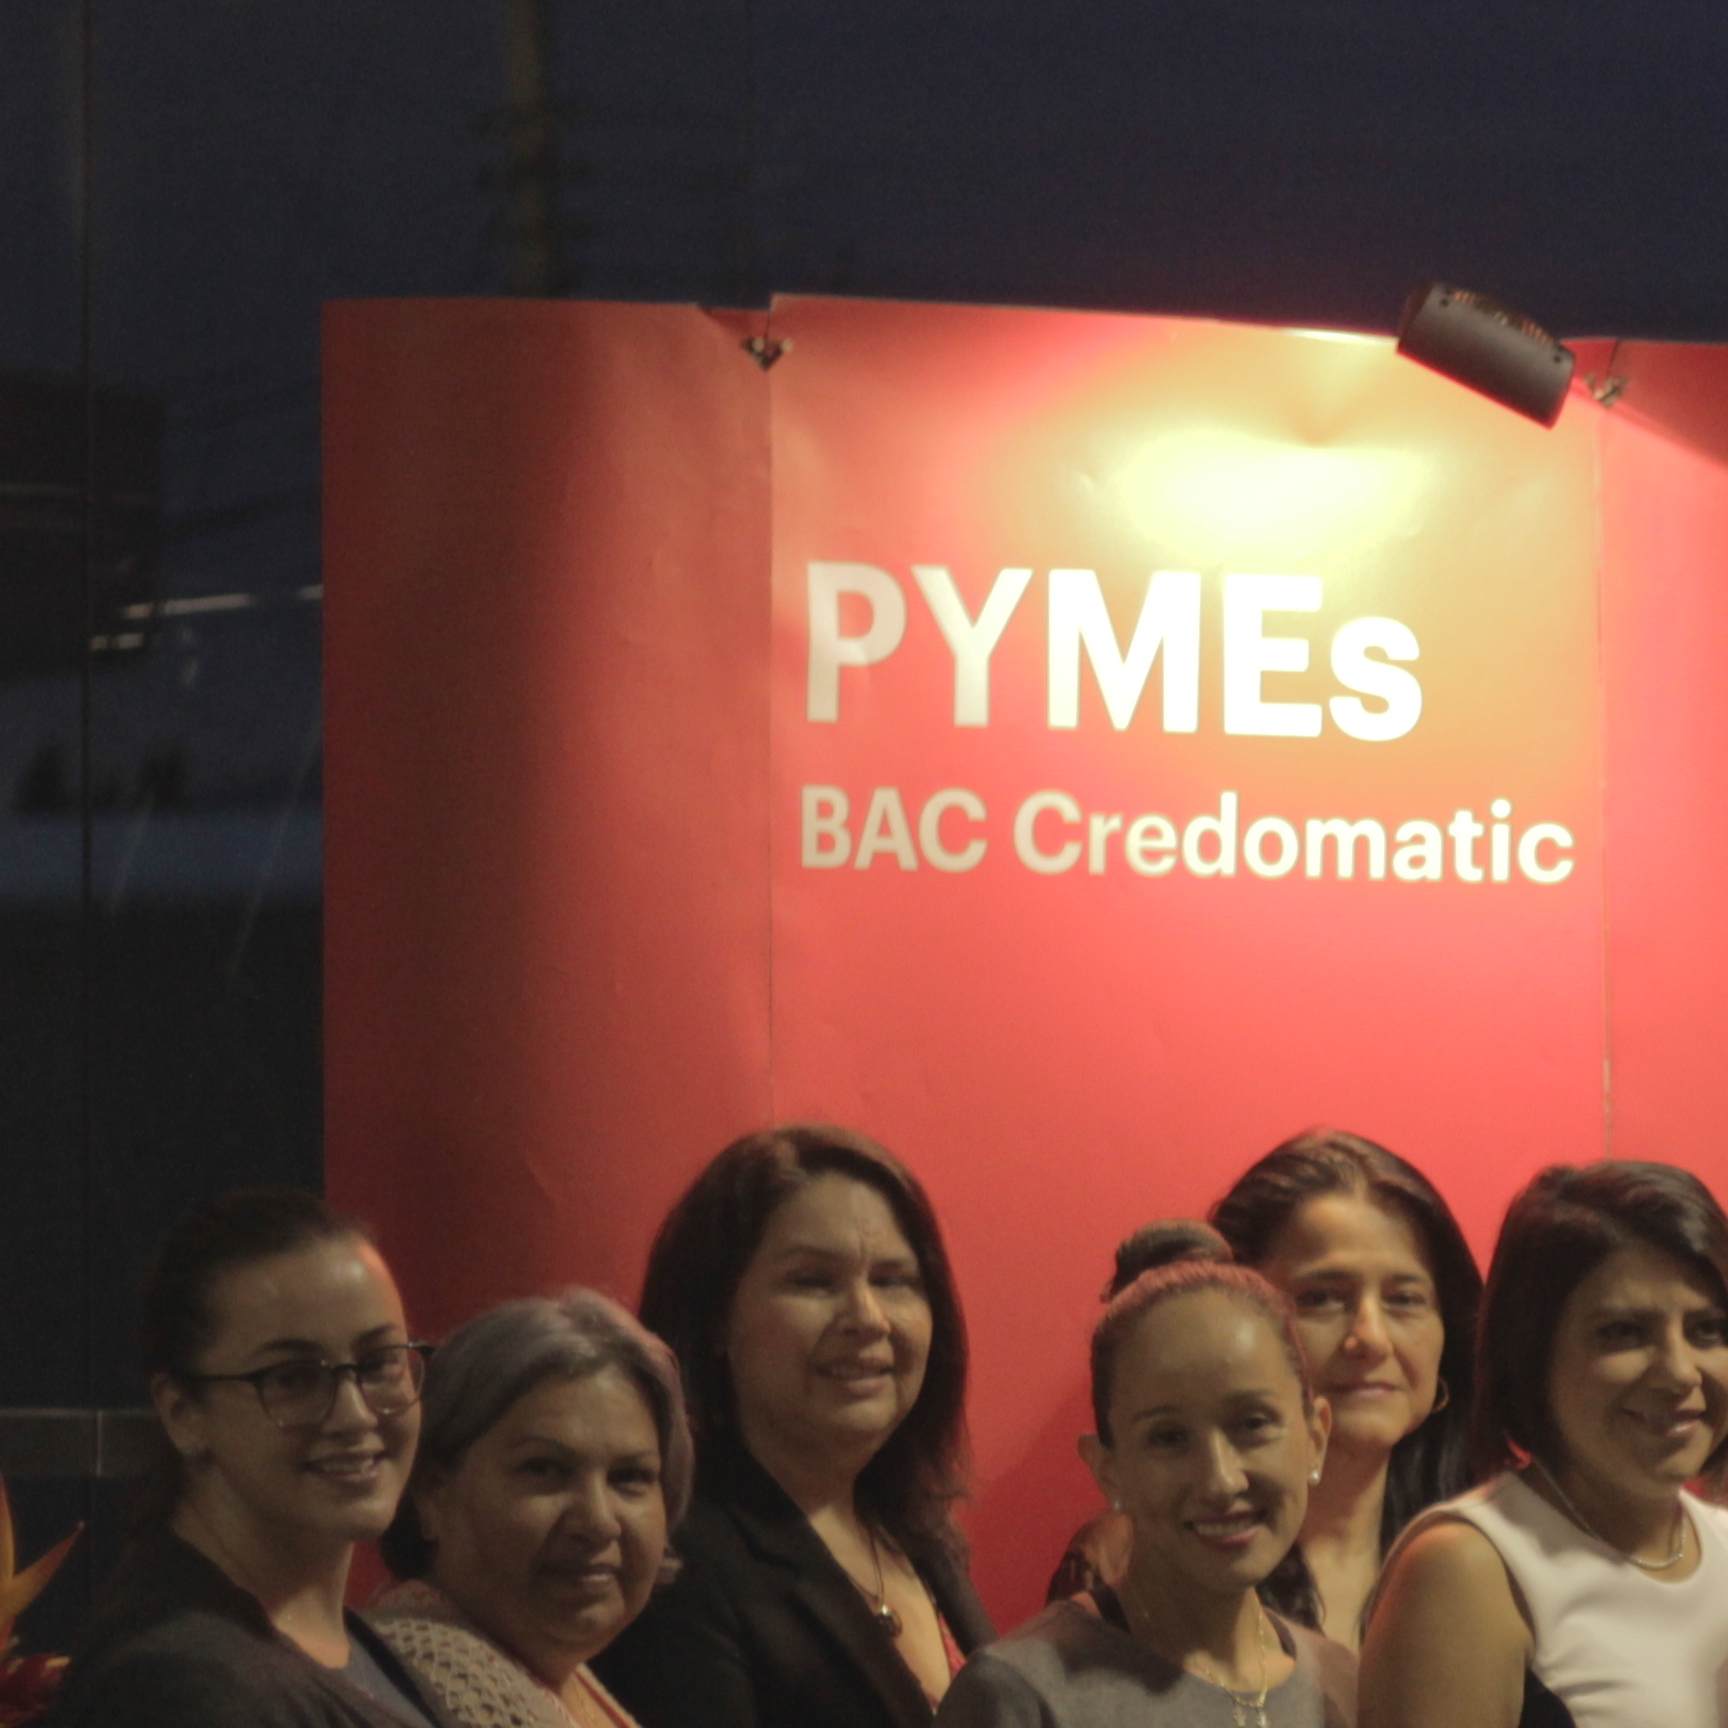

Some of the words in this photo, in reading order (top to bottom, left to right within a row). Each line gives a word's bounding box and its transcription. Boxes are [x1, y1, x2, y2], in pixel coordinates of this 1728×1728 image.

[806, 560, 1423, 741] PYMEs
[801, 785, 988, 872] BAC
[1013, 791, 1574, 884] Credomatic
